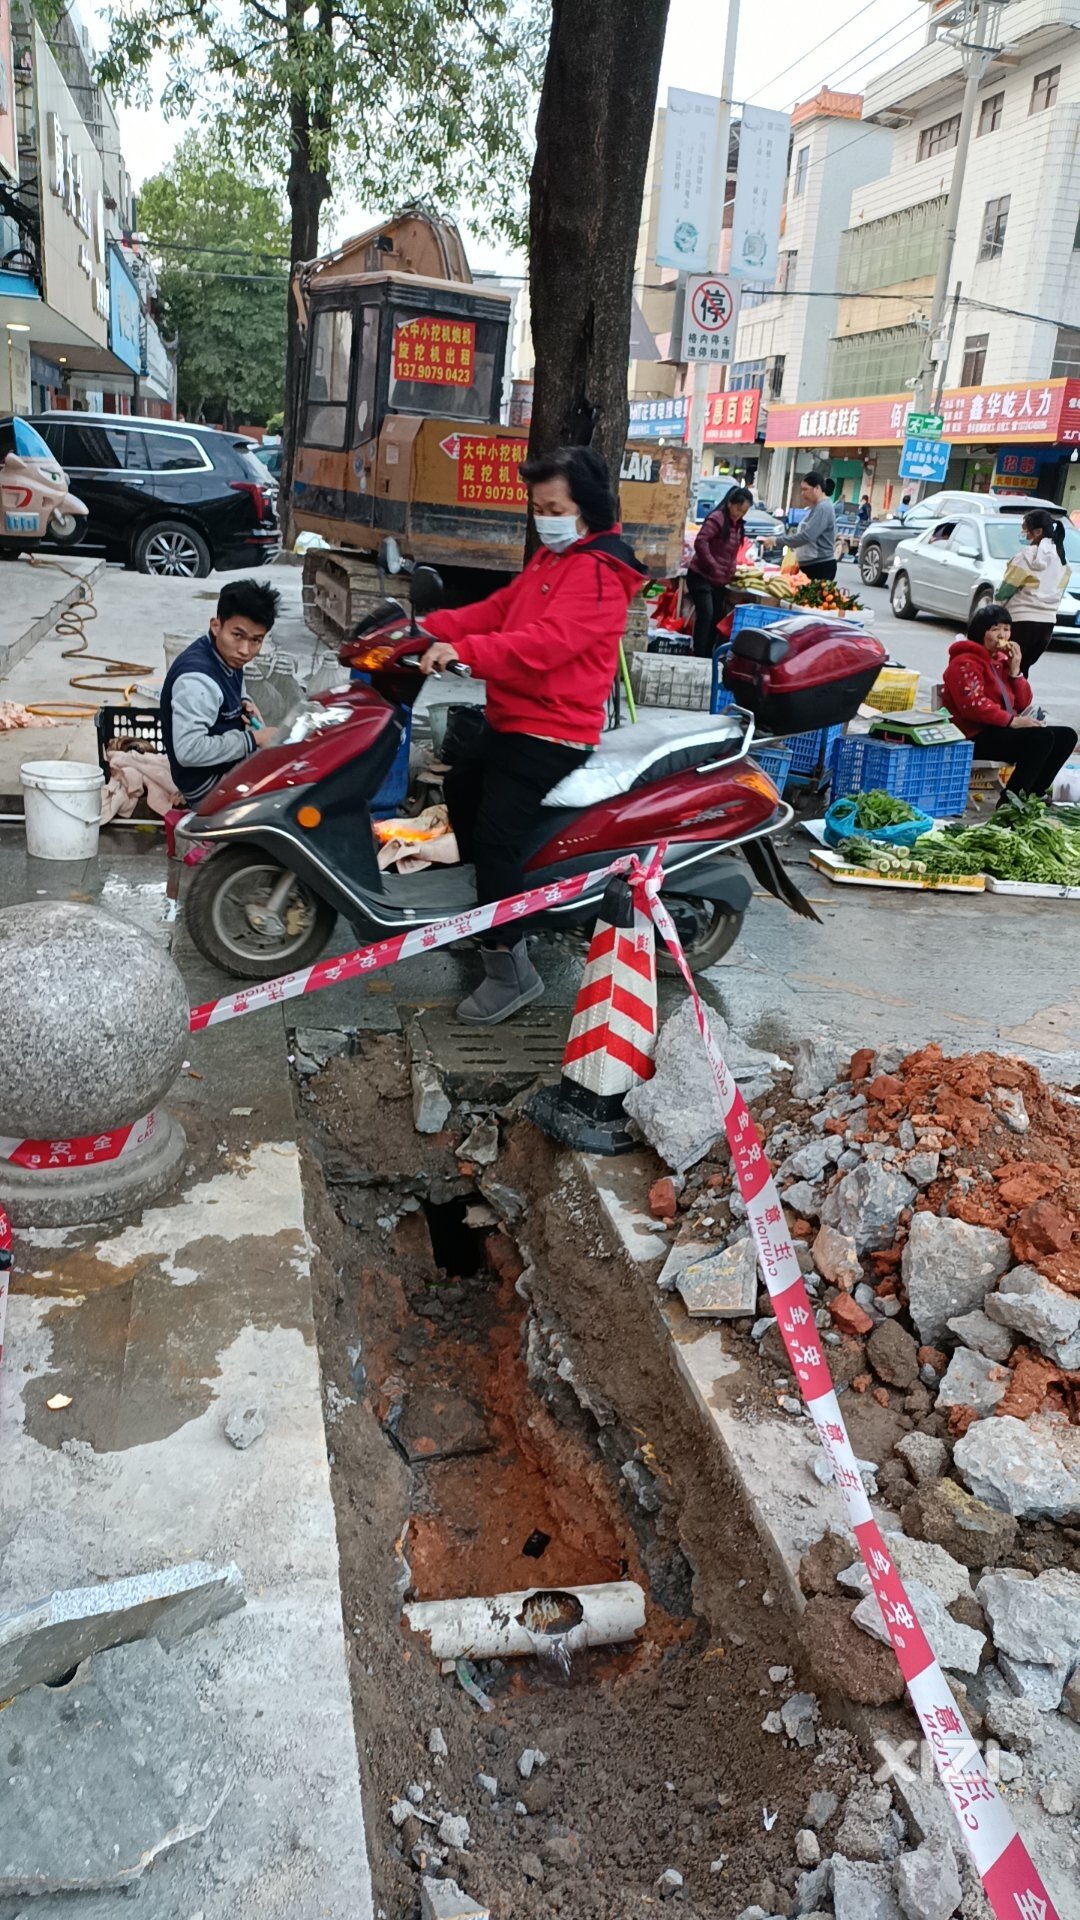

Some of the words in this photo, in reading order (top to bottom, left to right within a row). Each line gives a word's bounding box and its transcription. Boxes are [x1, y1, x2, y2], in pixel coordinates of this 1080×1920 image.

[701, 289, 726, 323] 停
[399, 320, 472, 345] 大中小挖机炮机
[688, 333, 730, 347] 格内停车
[399, 342, 471, 366] 旋挖机出租
[687, 346, 730, 360] 违停拍照
[397, 363, 415, 379] 137
[417, 365, 443, 380] 9079
[445, 367, 470, 383] 0423
[462, 484, 483, 499] 137
[485, 485, 514, 501] 9079
[420, 920, 472, 948] 注意
[424, 910, 483, 935] CAUTION
[339, 943, 388, 966] SAFE
[324, 954, 377, 980] 安全
[236, 976, 296, 1000] CAUTION
[50, 1135, 112, 1155] 安全
[31, 1152, 95, 1164] SAFE
